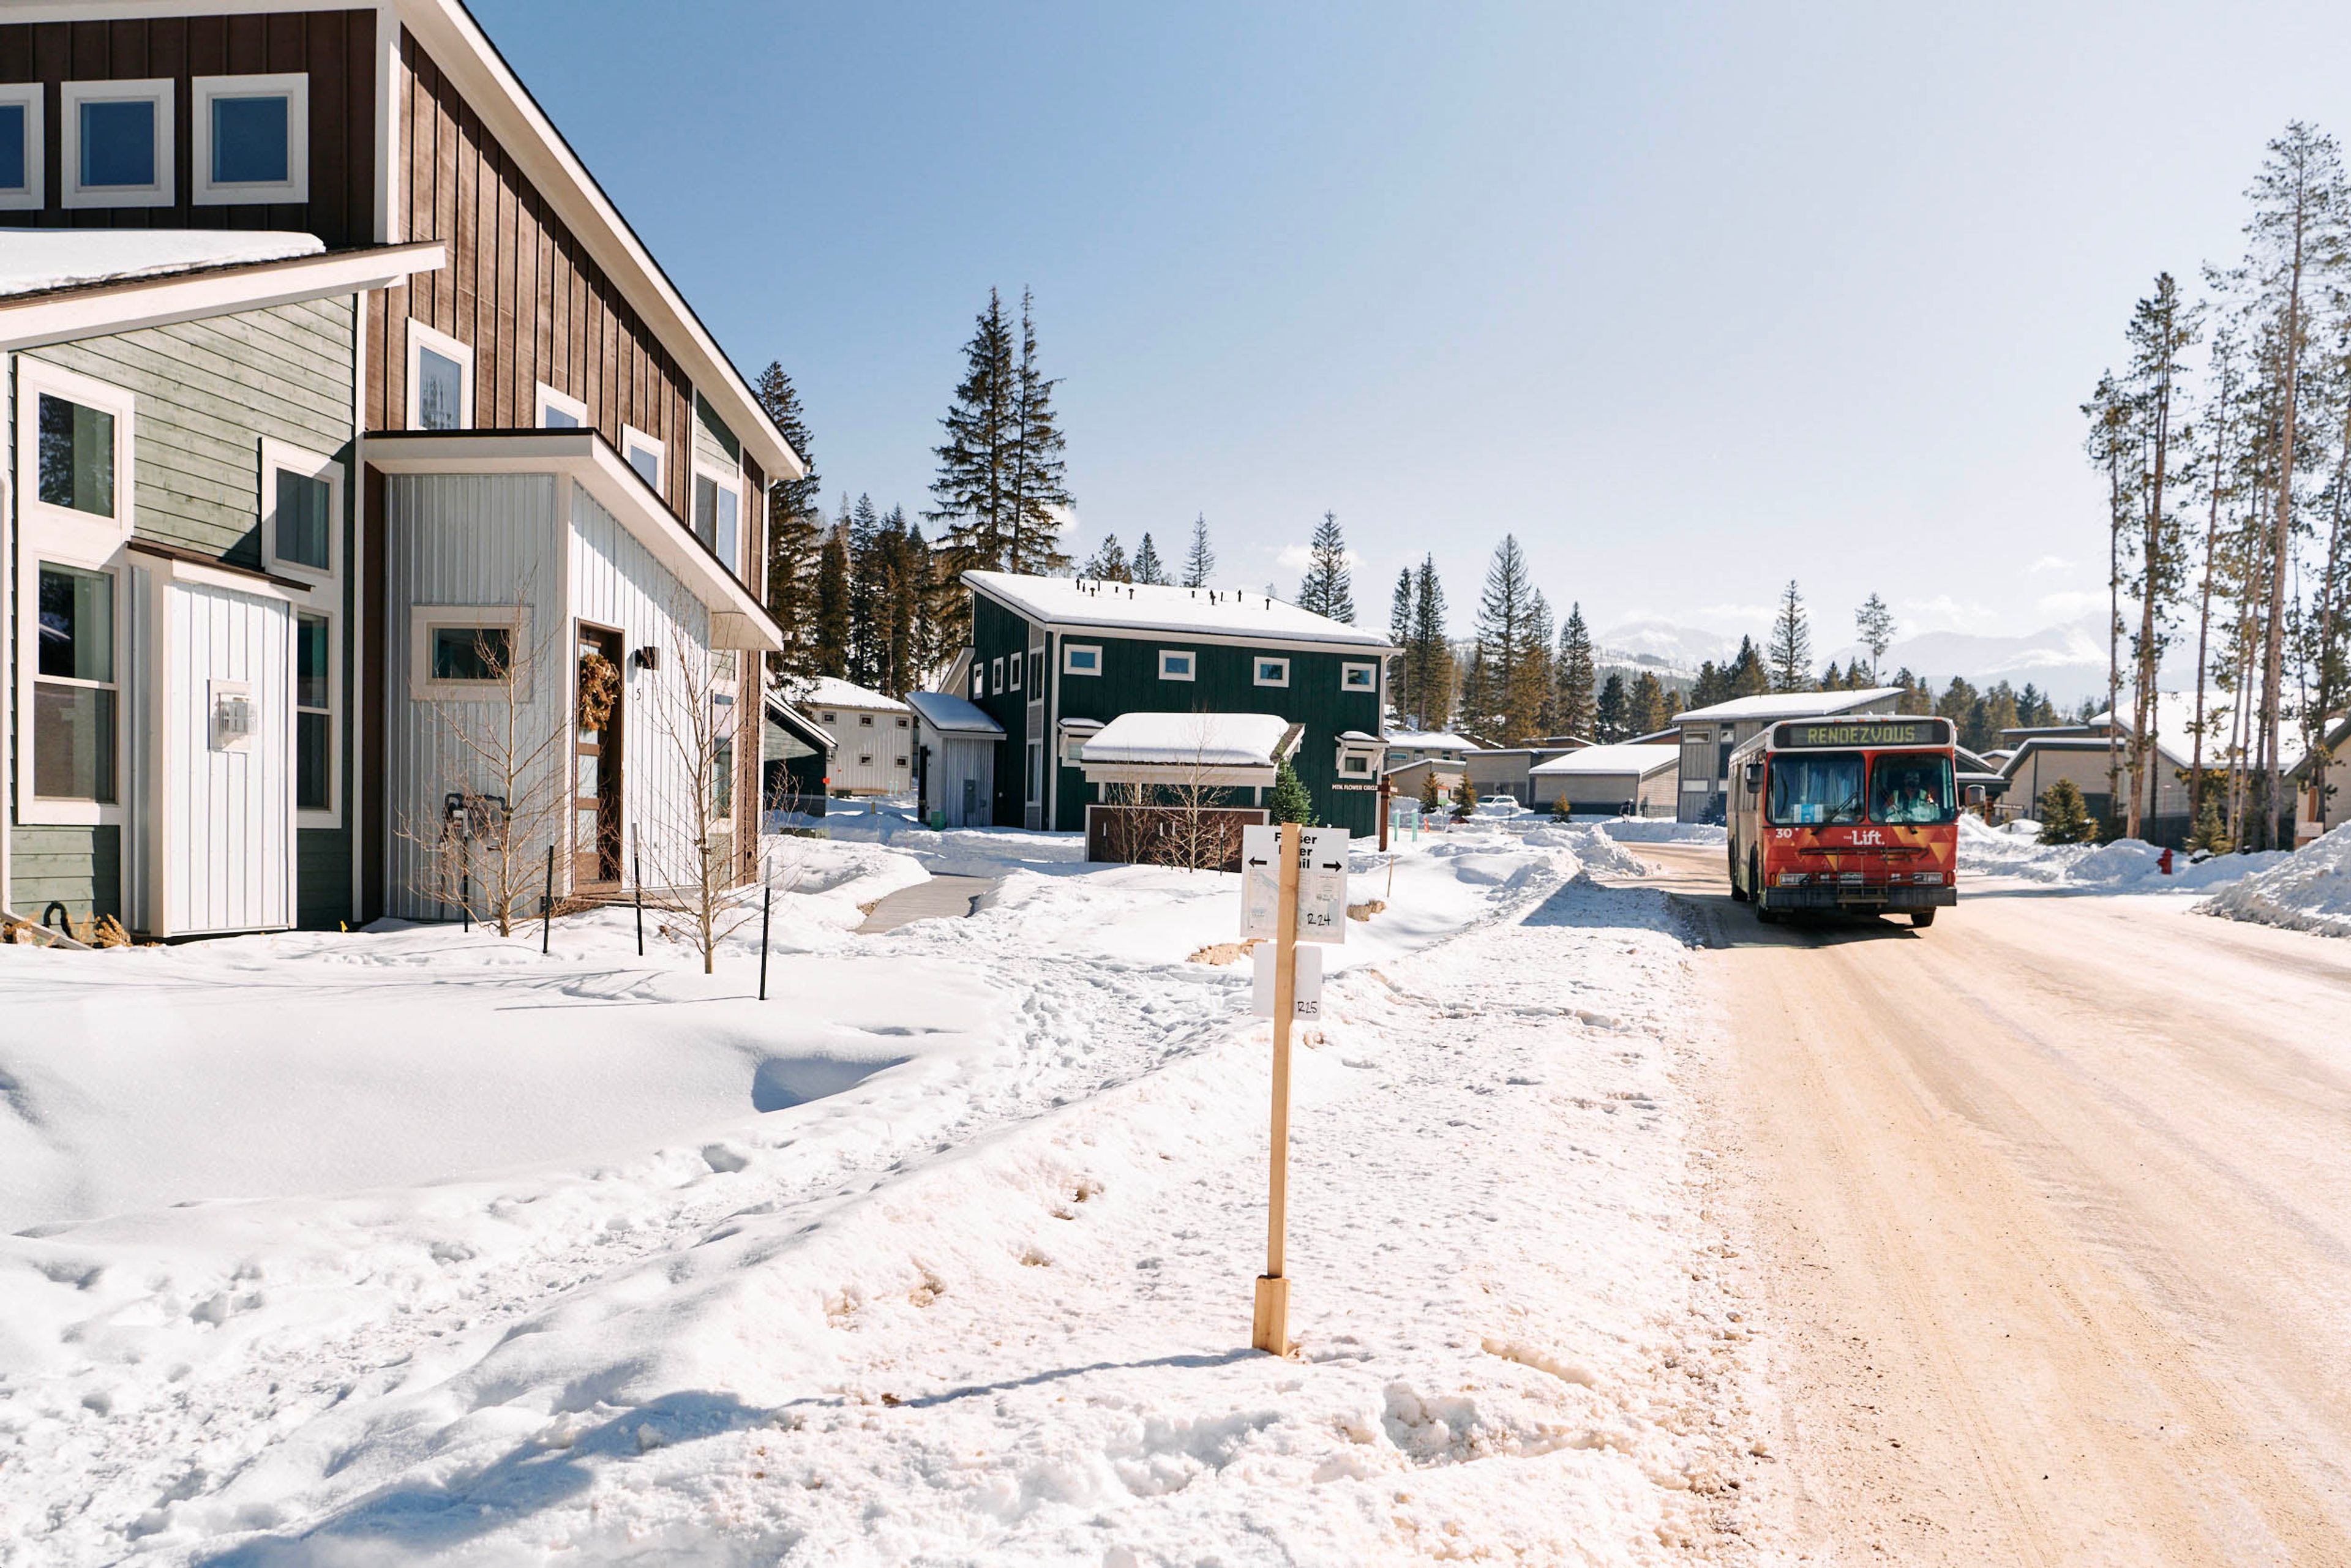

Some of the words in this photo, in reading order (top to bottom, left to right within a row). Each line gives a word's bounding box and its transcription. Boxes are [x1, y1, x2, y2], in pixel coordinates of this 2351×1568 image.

[636, 688, 641, 700] 5
[1808, 726, 1915, 744] RENDEZVOUS
[1275, 832, 1318, 844] Fer
[1775, 828, 1793, 839] 30
